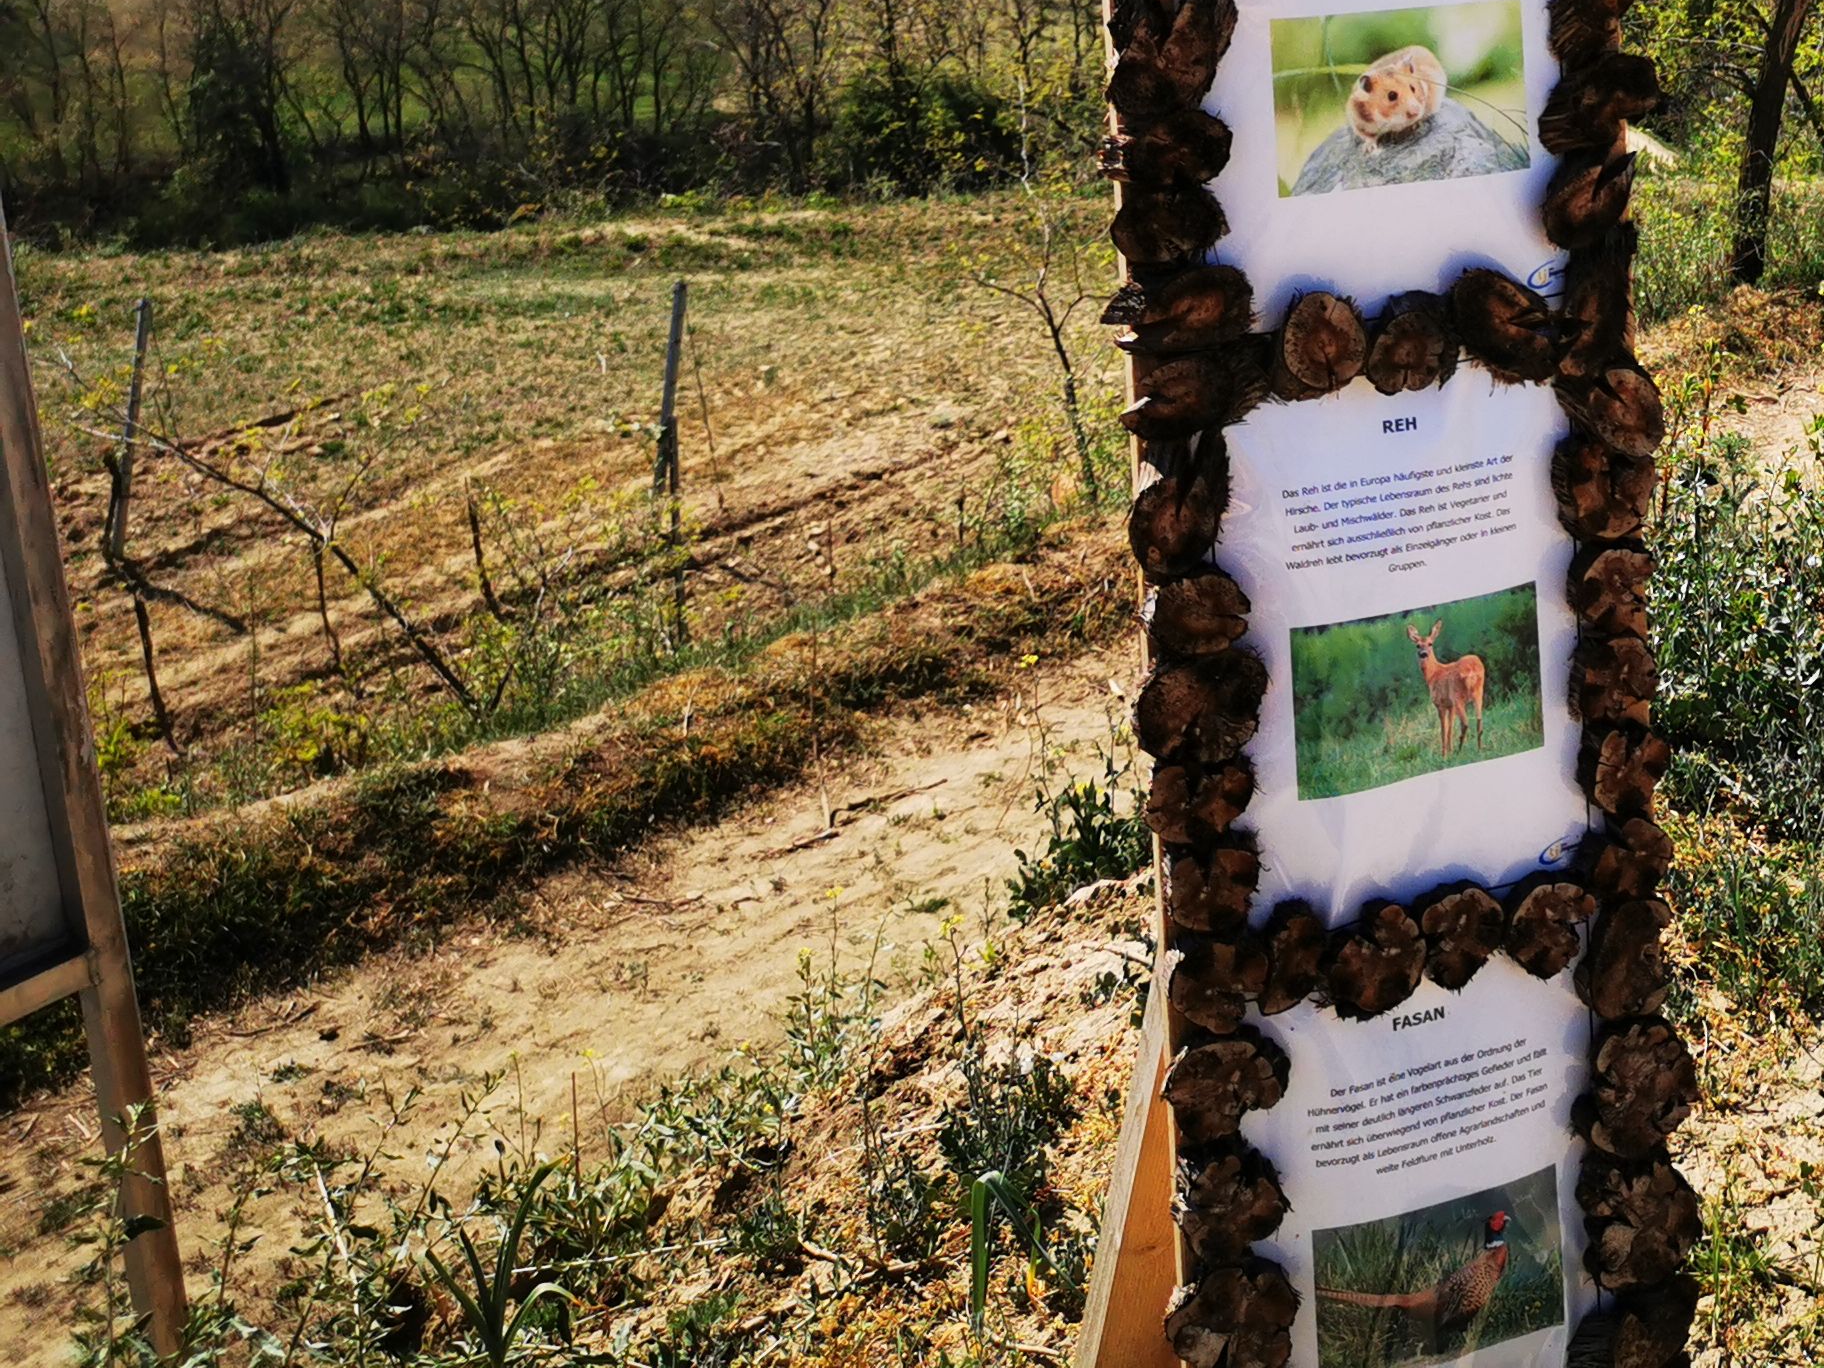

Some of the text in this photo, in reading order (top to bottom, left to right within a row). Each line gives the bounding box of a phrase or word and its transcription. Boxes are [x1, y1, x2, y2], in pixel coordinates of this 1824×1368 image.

[1383, 417, 1417, 433] REH
[1282, 490, 1299, 499] Das
[1302, 486, 1319, 495] Reh
[1322, 484, 1331, 492] ist
[1334, 482, 1347, 490] die
[1361, 476, 1391, 486] Europa
[1393, 470, 1434, 481] häufigste
[1437, 466, 1452, 476] und
[1486, 457, 1498, 465] Art
[1500, 455, 1513, 463] der
[1324, 502, 1339, 510] Der
[1435, 485, 1449, 494] des
[1453, 481, 1472, 490] Rehs
[1474, 476, 1490, 487] sind
[1322, 491, 1507, 529] und Das Reh ist und
[1292, 540, 1324, 551] ernährt
[1327, 537, 1344, 547] sich
[1408, 525, 1424, 533] von
[1345, 548, 1388, 562] bevorzugt
[1391, 545, 1403, 554] als
[1460, 533, 1478, 541] oder
[1393, 1007, 1445, 1031] FASAN
[1331, 1039, 1527, 1097] Der ist Vogelart aus der Ordnung der
[1369, 1053, 1531, 1107] Er hat ein Gefieder und
[1316, 1068, 1543, 1133] mit seiner deutlich längeren Schwanzfeder Das Tier
[1311, 1140, 1344, 1151] ernährt
[1347, 1136, 1364, 1146] sich
[1367, 1120, 1420, 1142] überwiegend
[1423, 1118, 1438, 1127] von
[1511, 1092, 1523, 1101] Der
[1316, 1154, 1360, 1167] bevorzugt
[1362, 1152, 1374, 1161] als
[1431, 1130, 1457, 1143] offene
[1532, 1100, 1545, 1111] und
[1440, 1148, 1453, 1158] mit
